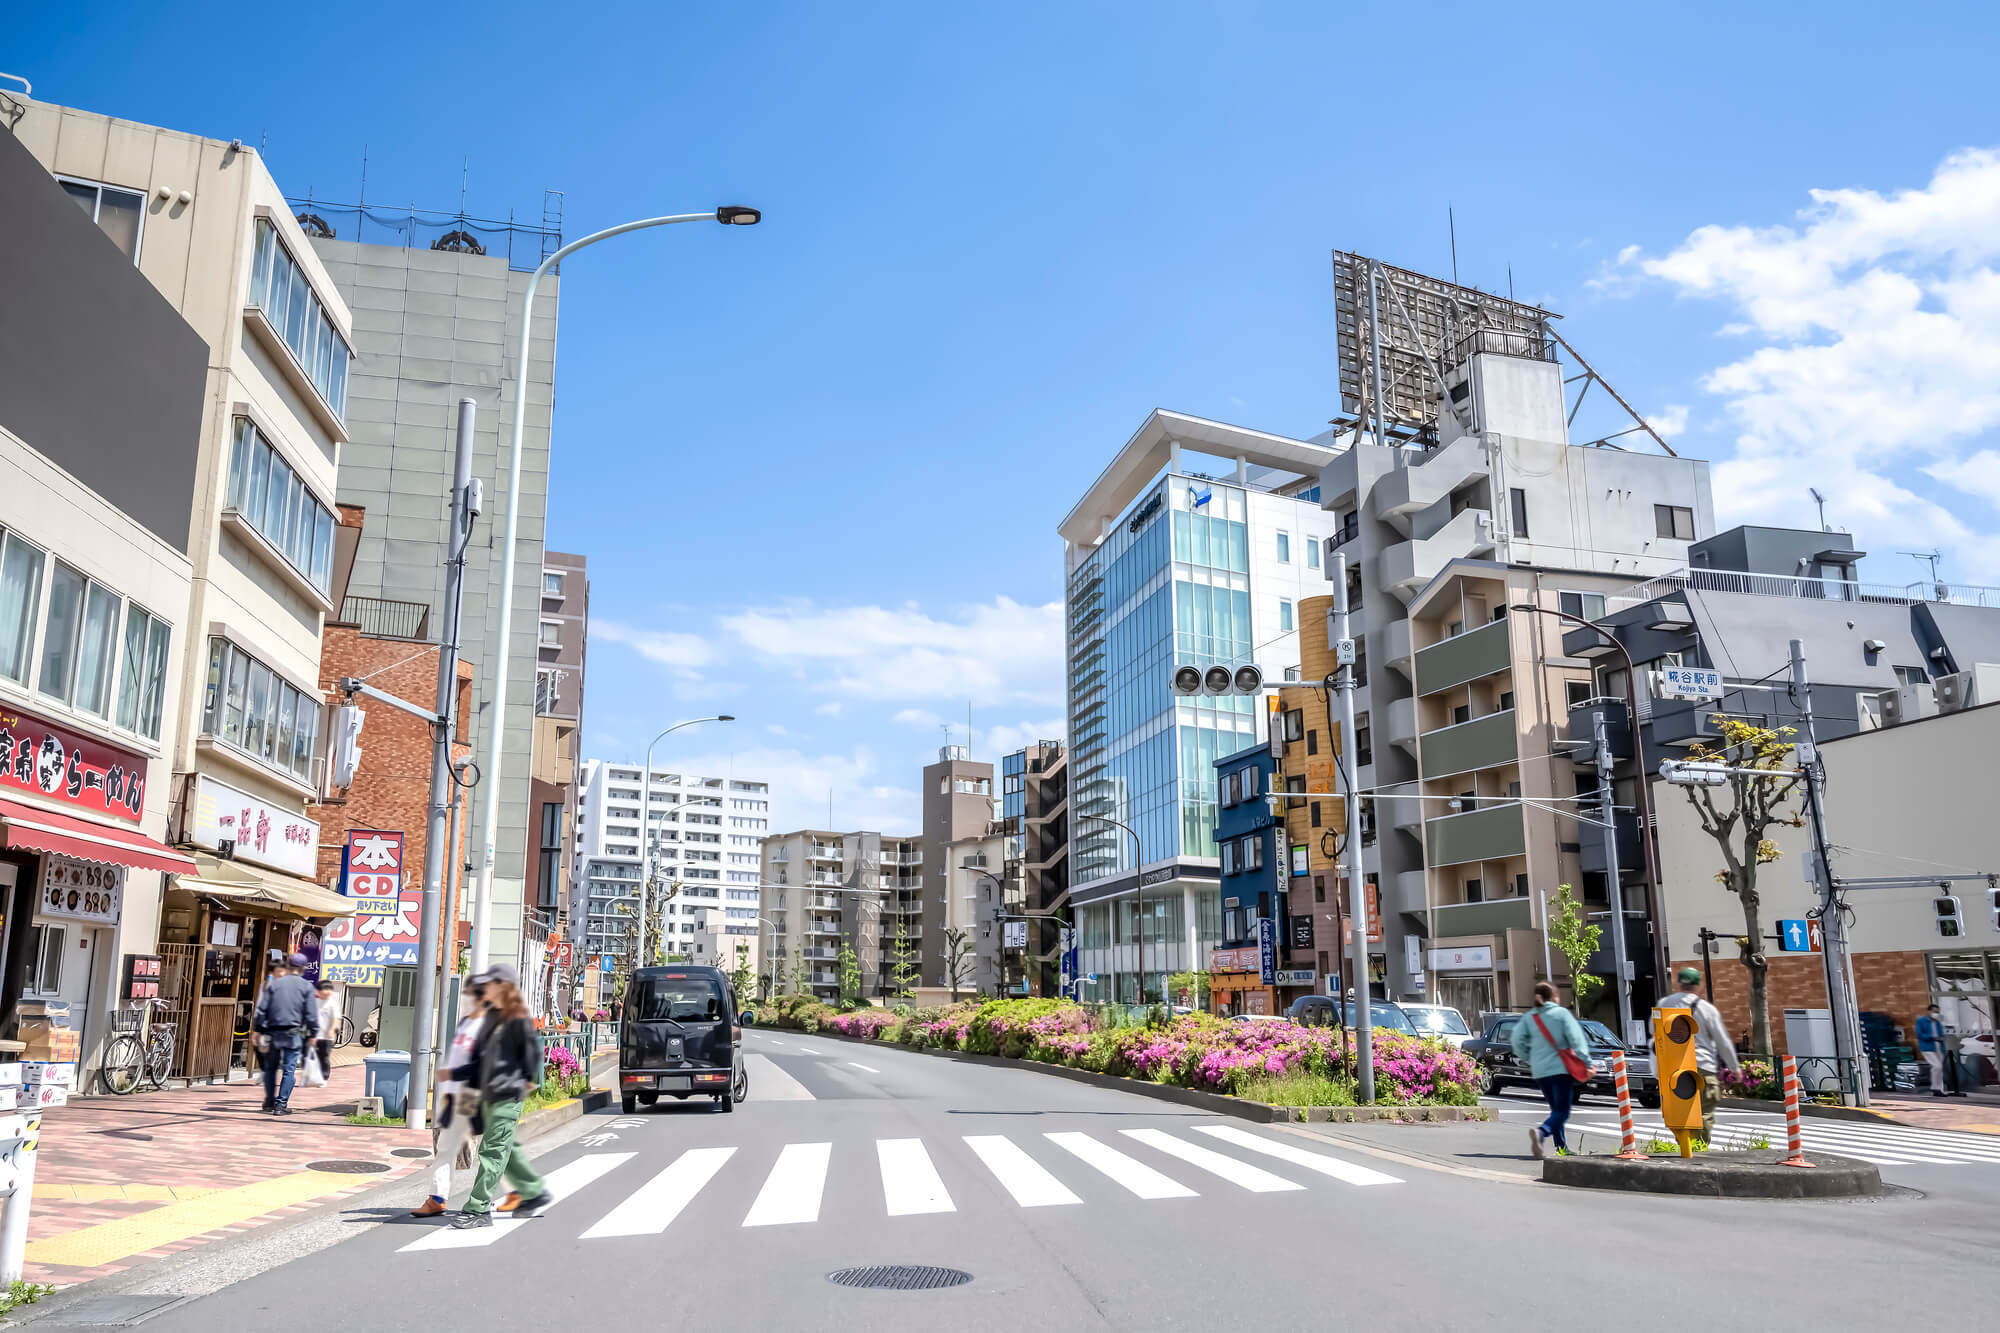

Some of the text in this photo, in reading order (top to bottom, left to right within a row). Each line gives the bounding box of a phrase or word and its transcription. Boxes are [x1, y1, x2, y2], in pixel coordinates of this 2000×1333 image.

[1669, 671, 1718, 686] 糀谷駅前
[1678, 685, 1696, 693] Kojiya
[0, 712, 18, 728] ーツ
[66, 749, 143, 814] らーめん
[351, 834, 399, 870] 本
[353, 876, 393, 896] CD
[1279, 879, 1286, 890] 24
[358, 901, 419, 940] 本
[324, 944, 417, 962] DVD・ゲーム
